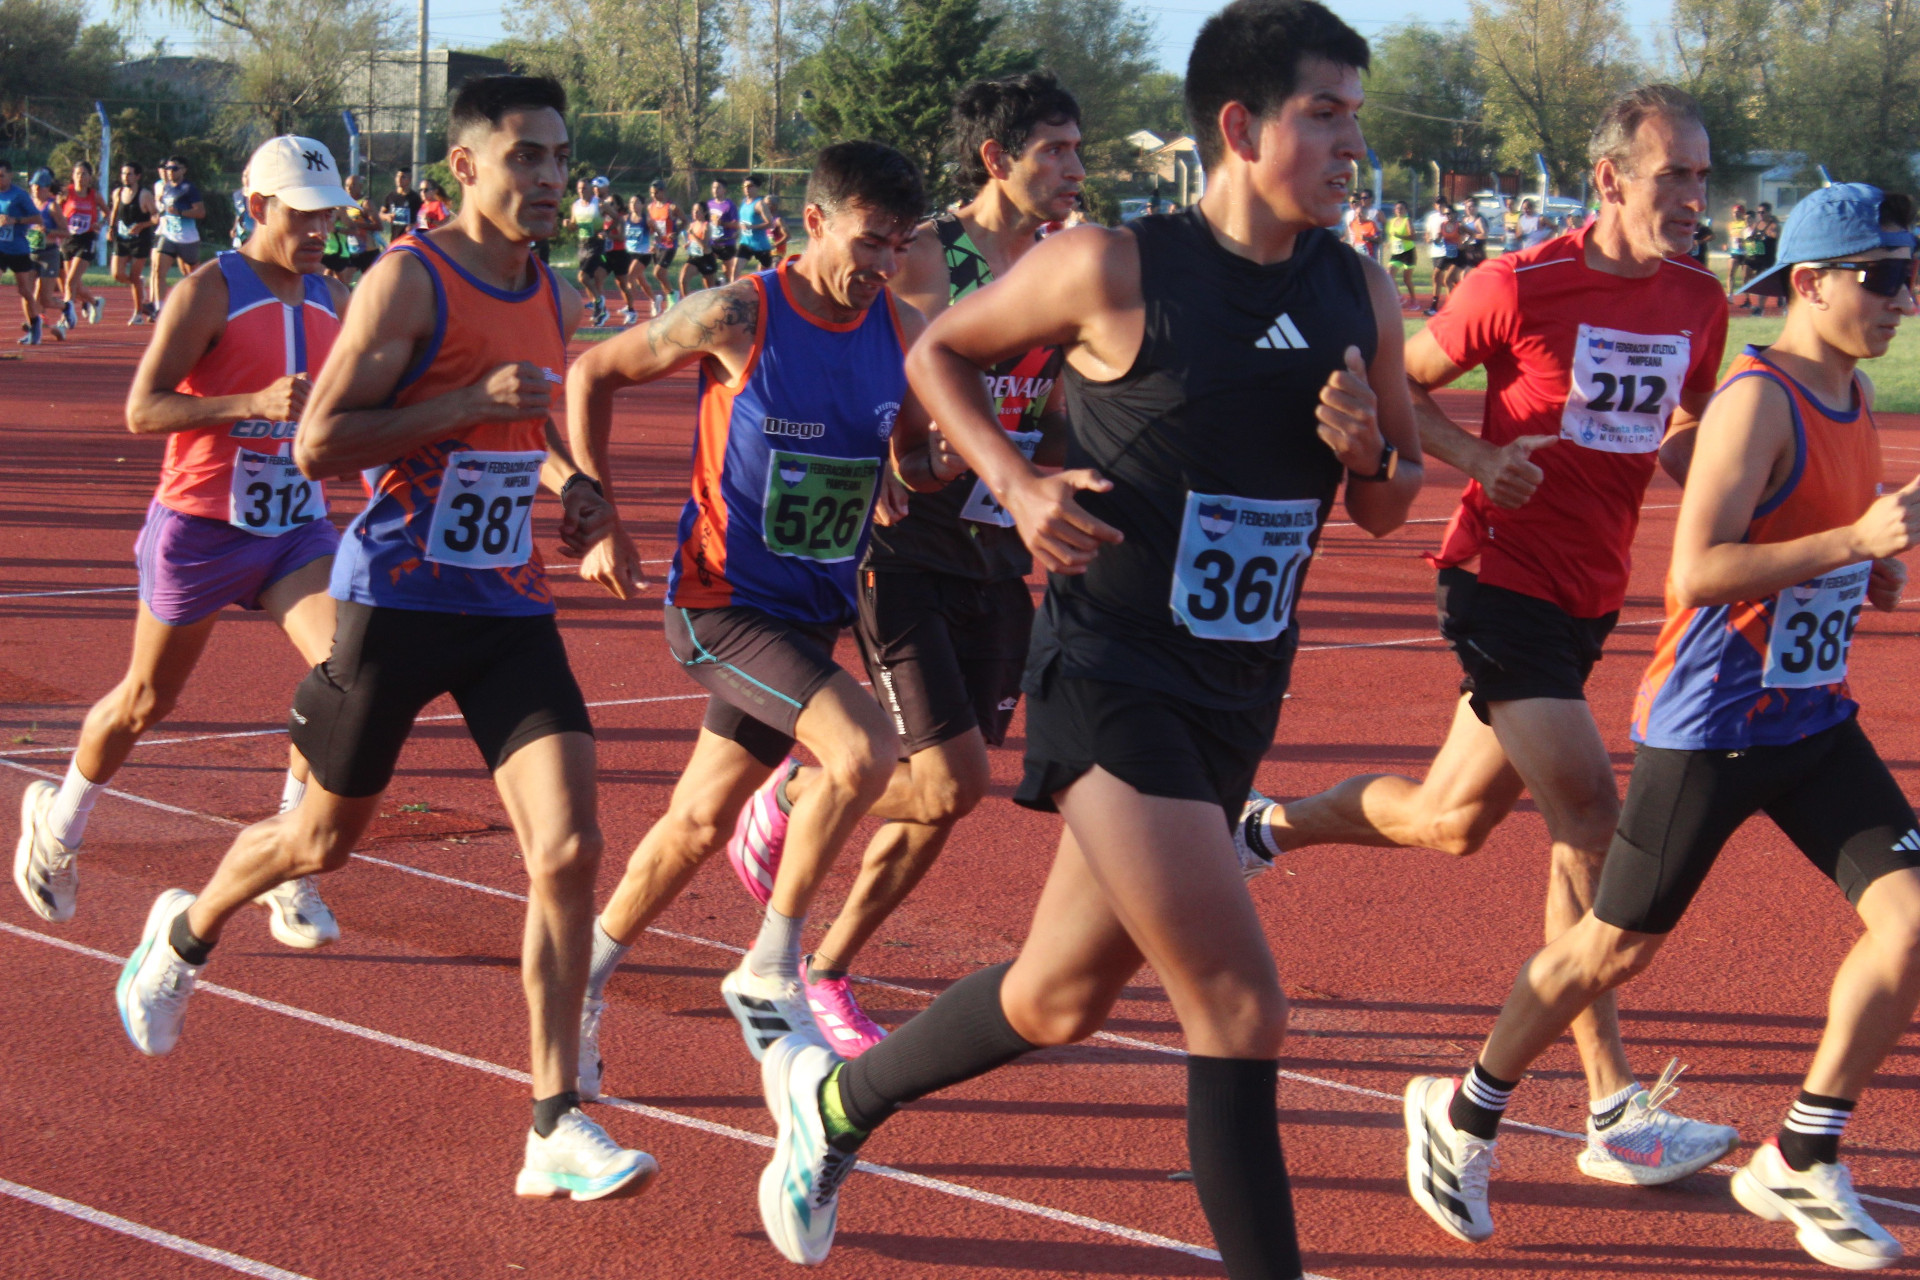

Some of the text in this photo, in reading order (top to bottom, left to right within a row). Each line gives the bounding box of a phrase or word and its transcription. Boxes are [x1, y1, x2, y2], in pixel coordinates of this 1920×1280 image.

[1586, 372, 1667, 414] 212
[764, 417, 825, 439] Diego
[1600, 423, 1631, 433] Santa
[244, 481, 314, 527] 312
[444, 493, 534, 555] 387
[774, 494, 865, 549] 526
[1187, 549, 1300, 625] 360
